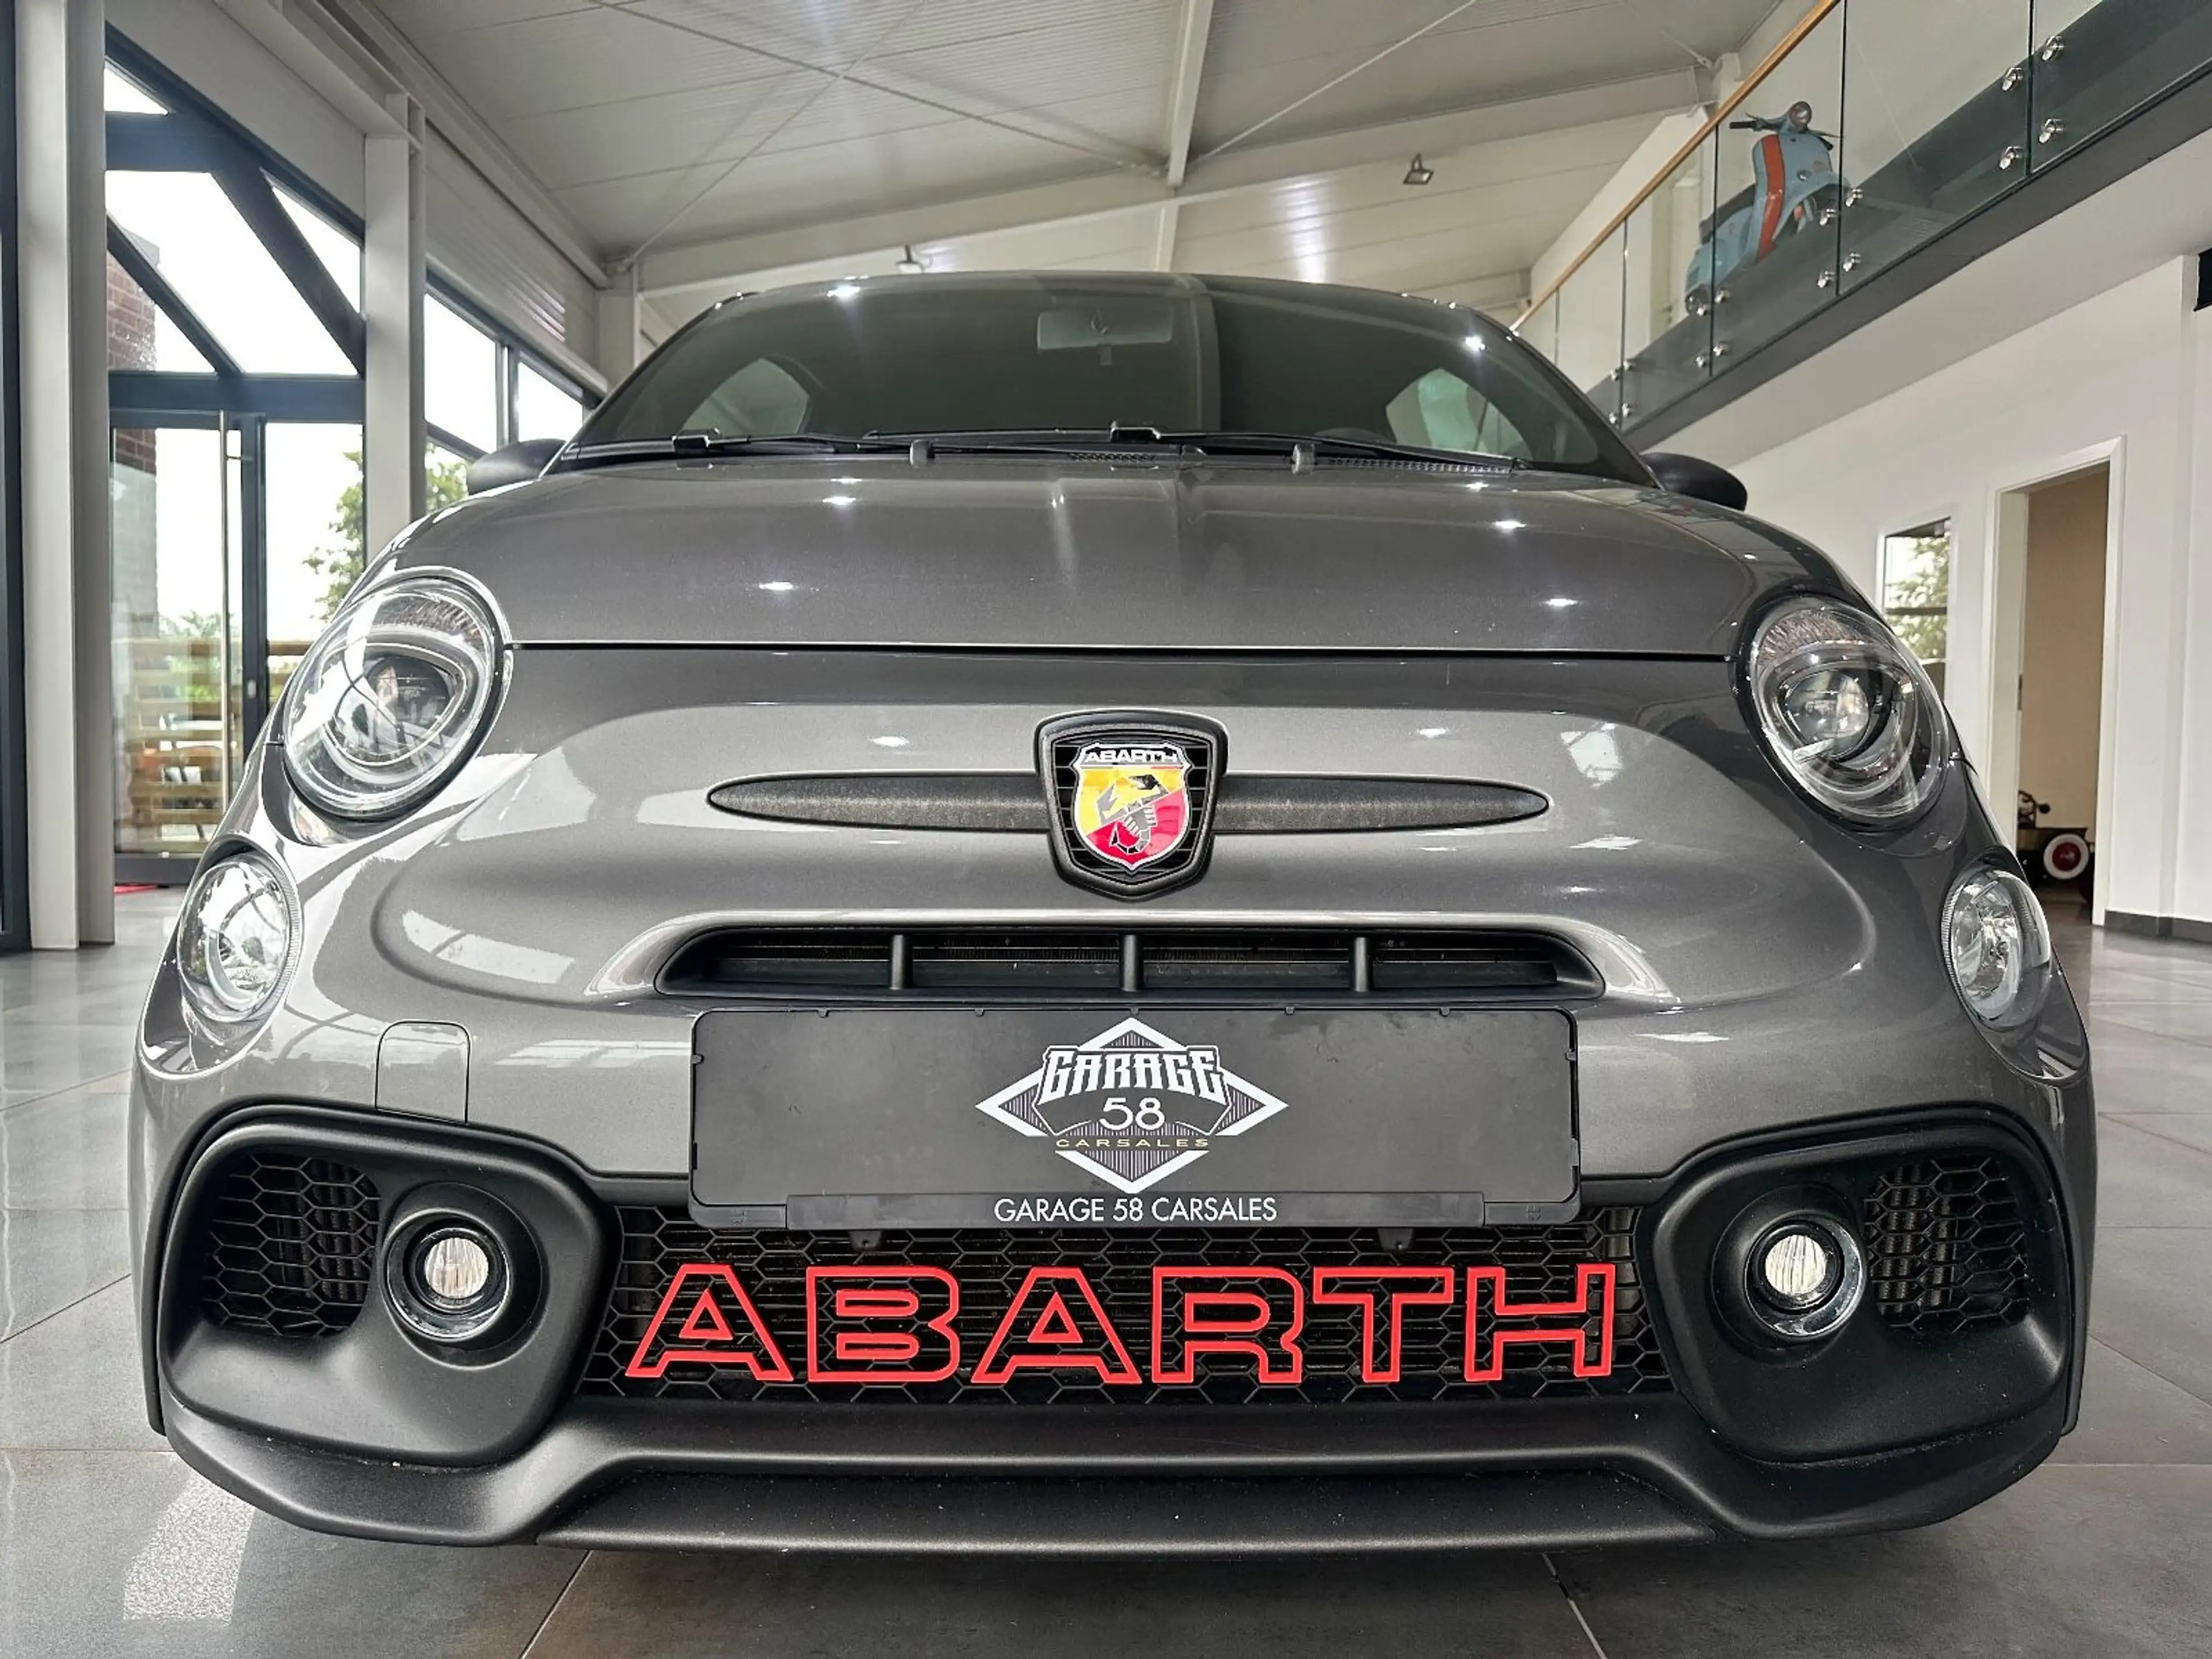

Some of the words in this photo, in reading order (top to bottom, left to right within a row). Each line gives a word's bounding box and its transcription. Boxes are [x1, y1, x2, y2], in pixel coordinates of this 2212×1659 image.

[1084, 749, 1179, 763] ABARTH
[1037, 1050, 1228, 1106] GARAGE
[1099, 1097, 1166, 1131] 58
[1055, 1138, 1210, 1148] CARSALES
[994, 1197, 1104, 1222] GARAGE
[1113, 1197, 1143, 1222] 58
[1151, 1197, 1278, 1222] CARSALES
[625, 1263, 1616, 1385] ABARTH
